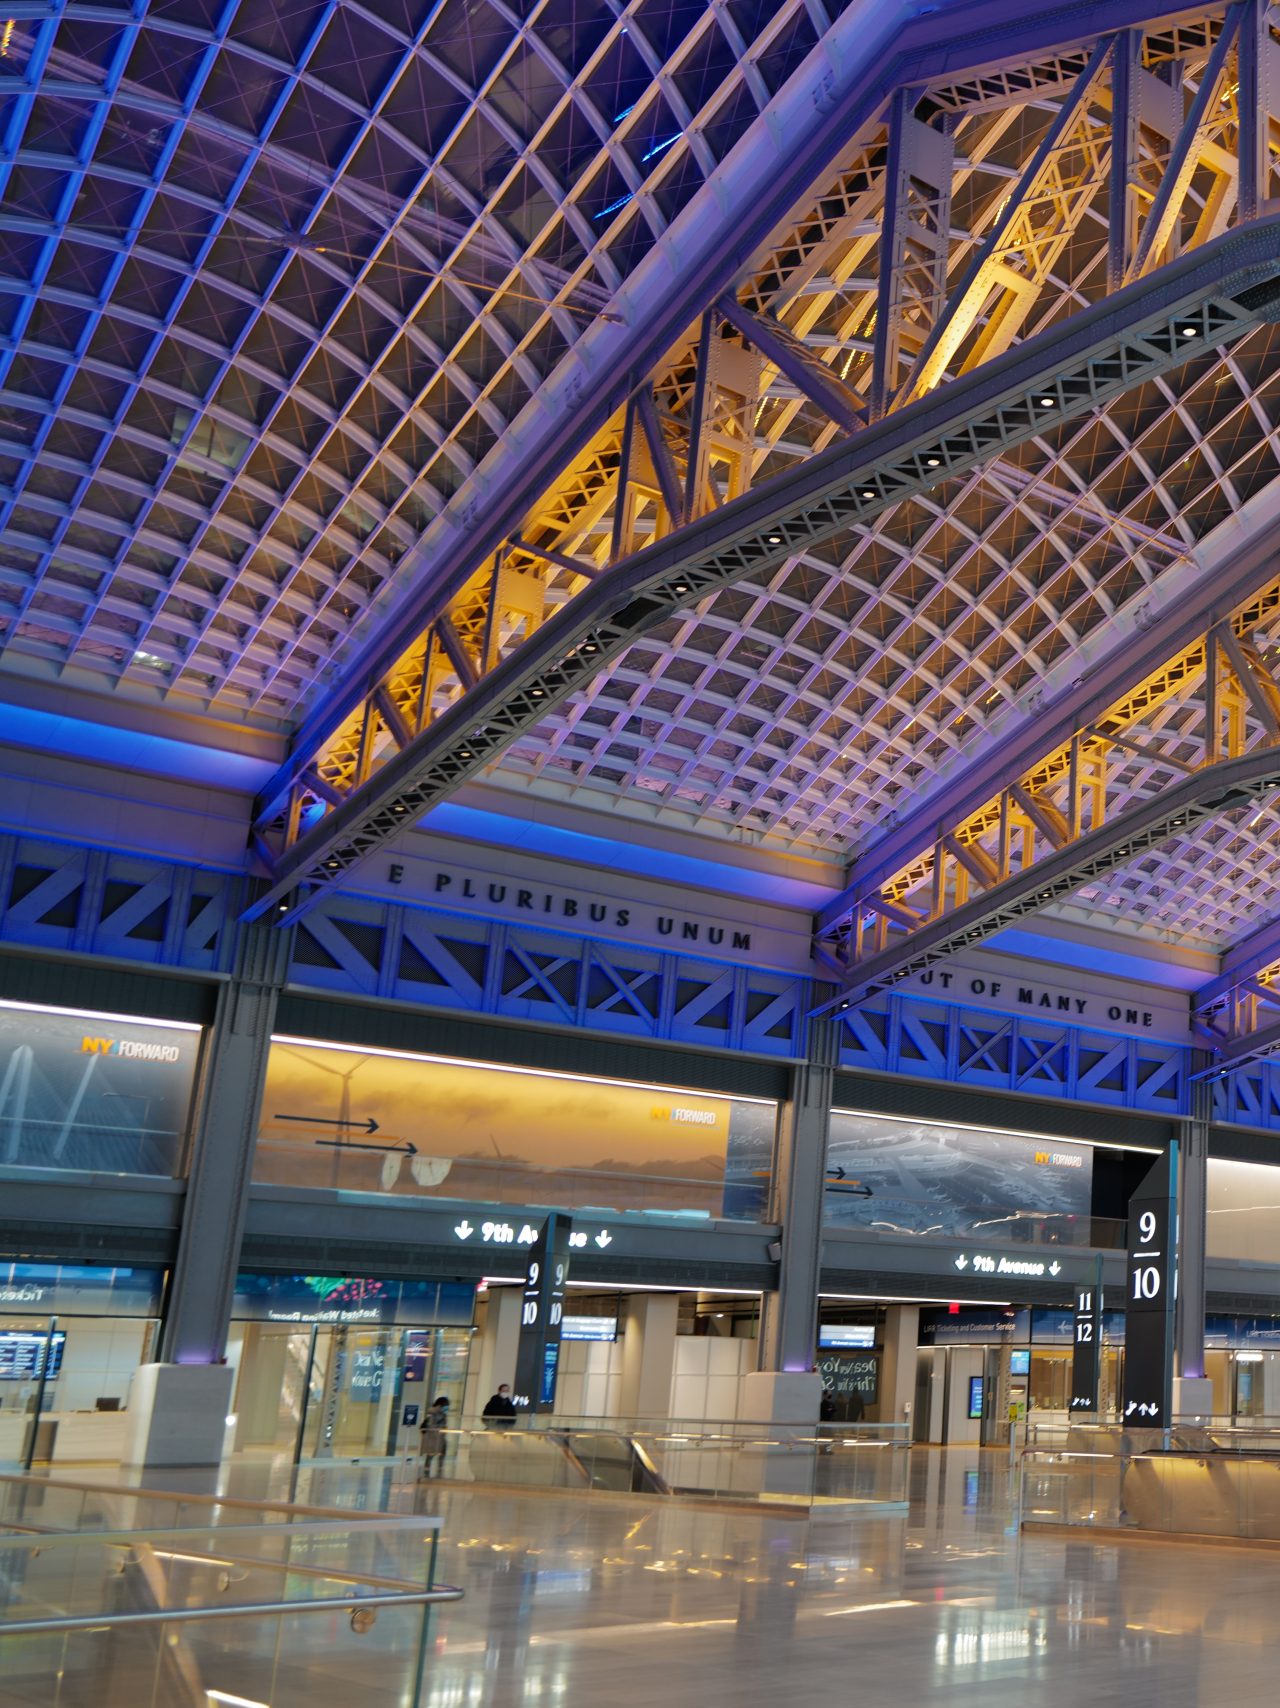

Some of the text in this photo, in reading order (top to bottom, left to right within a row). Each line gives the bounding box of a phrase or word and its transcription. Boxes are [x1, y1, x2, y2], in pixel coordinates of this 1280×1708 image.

[388, 864, 752, 950] E PLURIBUS UNUM
[920, 970, 1153, 1027] UT OF MANY ONE
[82, 1036, 180, 1062] NY FORWARD
[675, 1109, 716, 1125] FORWARD
[1053, 1153, 1082, 1168] FORWARD
[481, 1221, 514, 1243] 9th
[1139, 1211, 1156, 1243] 9
[528, 1262, 540, 1286] 9
[555, 1263, 564, 1286] 9
[973, 1255, 1045, 1276] 9th Avenue
[1132, 1266, 1160, 1299] 10
[522, 1301, 538, 1325] 10
[1078, 1292, 1091, 1311] 11
[550, 1302, 562, 1325] 10
[970, 1322, 995, 1332] Customer
[996, 1322, 1016, 1331] Service
[1076, 1323, 1093, 1342] 12
